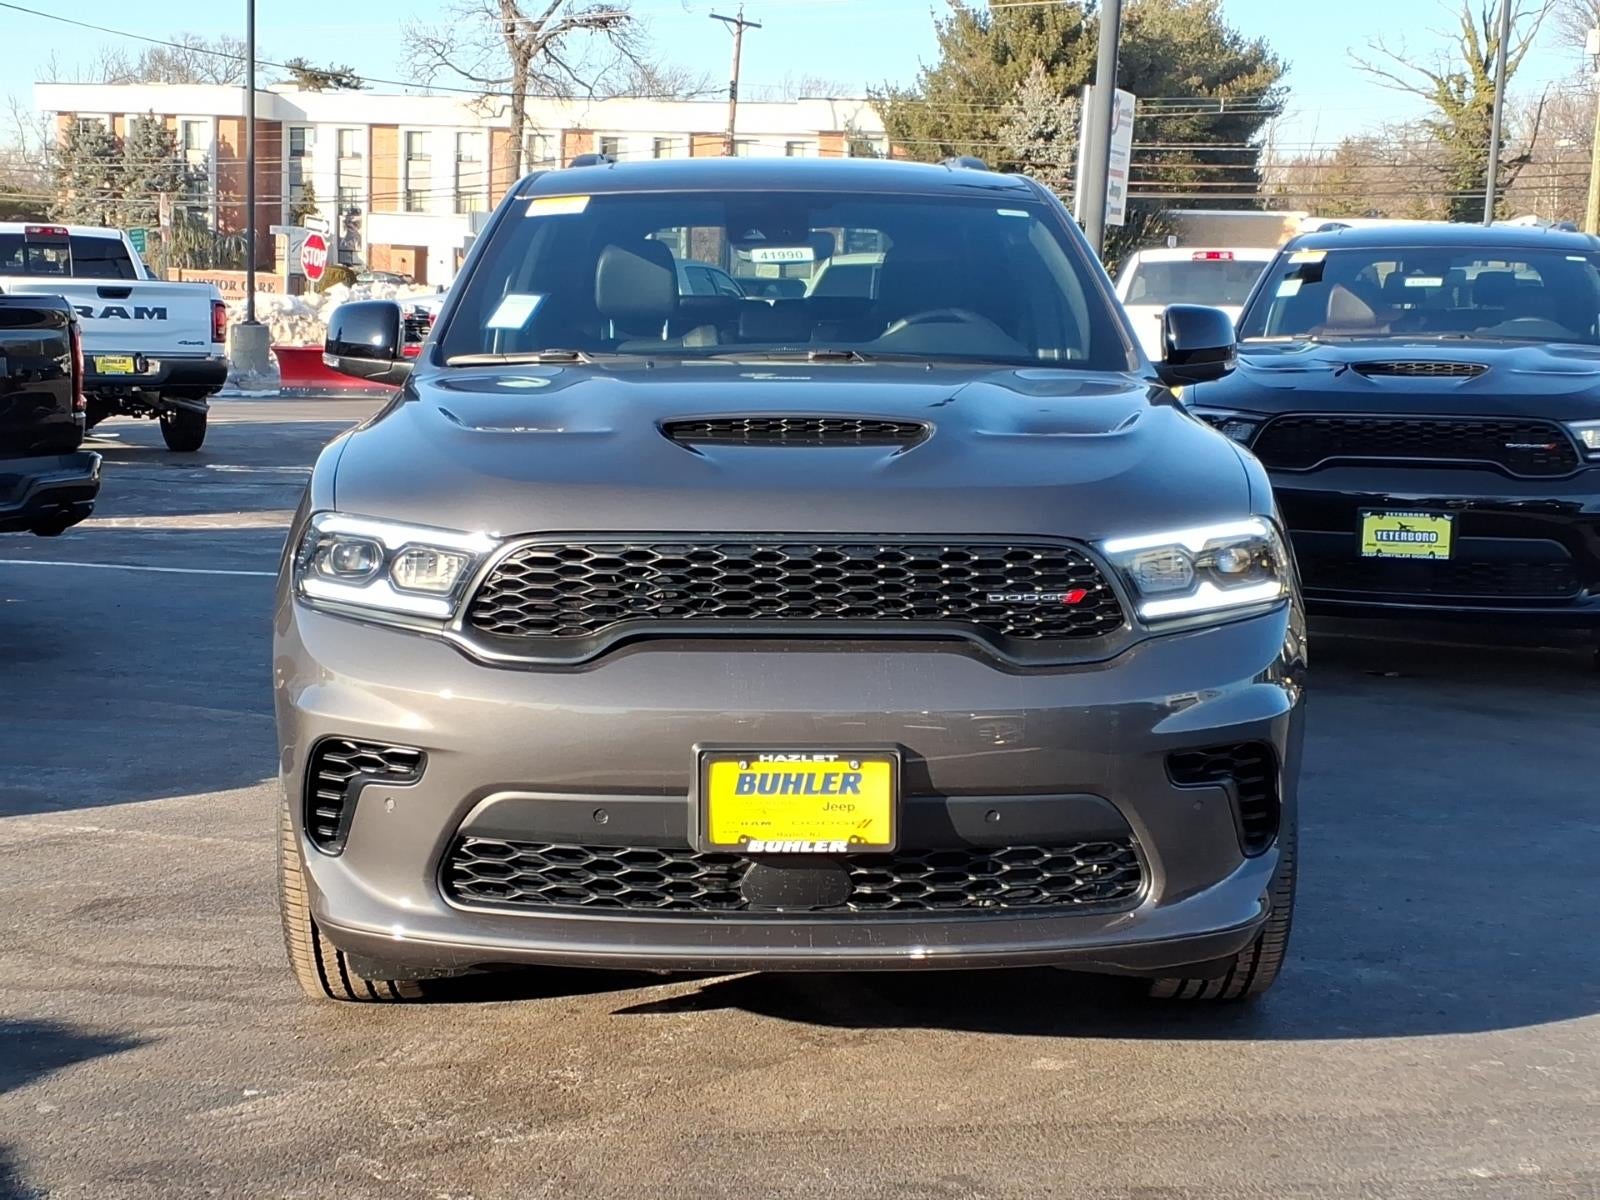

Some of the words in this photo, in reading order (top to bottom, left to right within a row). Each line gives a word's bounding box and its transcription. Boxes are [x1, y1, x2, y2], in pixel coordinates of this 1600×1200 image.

[303, 246, 327, 267] STOP
[761, 251, 803, 260] 41990
[241, 280, 275, 293] CRE
[73, 305, 167, 320] RAM
[1376, 531, 1437, 541] TETERBORO
[986, 593, 1072, 602] DODGE
[759, 754, 839, 762] HAZLET
[735, 772, 862, 795] BUHLER
[822, 802, 856, 813] Jeep
[747, 840, 848, 852] BUHLER
